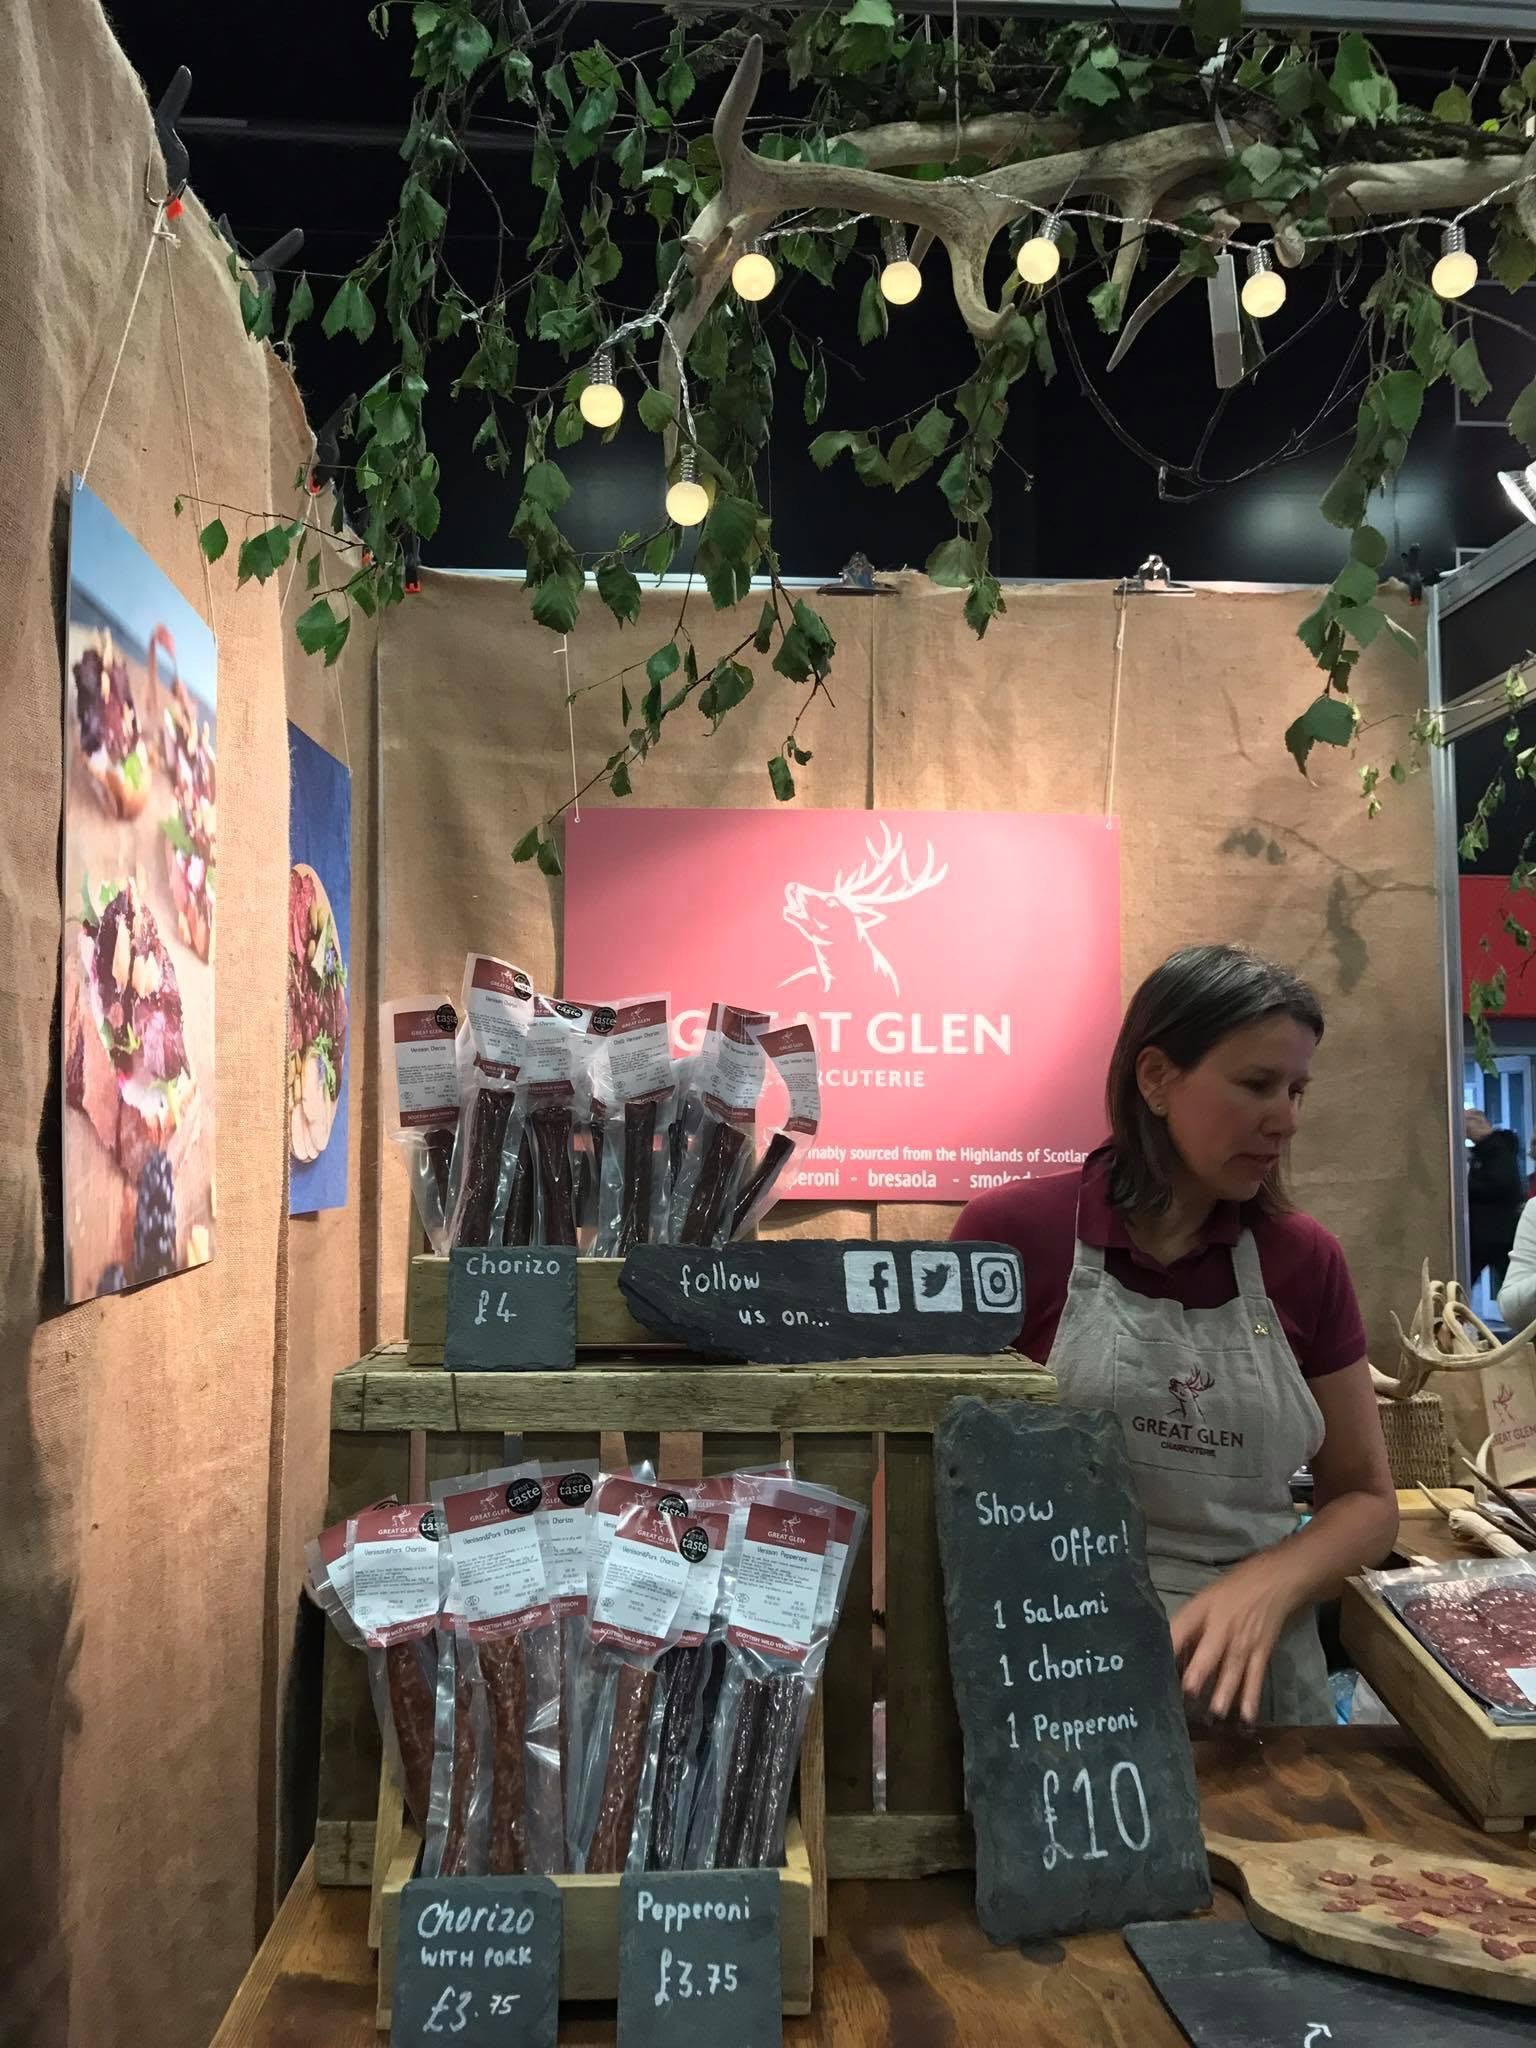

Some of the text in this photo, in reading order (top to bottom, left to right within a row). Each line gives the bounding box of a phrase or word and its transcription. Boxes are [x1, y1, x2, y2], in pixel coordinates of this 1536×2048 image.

[436, 1014, 458, 1025] taste
[557, 1004, 581, 1017] taste
[593, 1016, 617, 1026] taste
[866, 1011, 1012, 1055] GLEN
[850, 1146, 900, 1161] sourced
[902, 1146, 932, 1161] from
[936, 1146, 957, 1162] the
[960, 1147, 1023, 1165] Highlands
[1026, 1148, 1041, 1163] of
[1043, 1148, 1090, 1163] Scotlan
[867, 1168, 937, 1188] bresaola
[680, 1261, 761, 1298] follow
[473, 1290, 518, 1326] £4
[739, 1308, 831, 1328] us on...
[1132, 1416, 1244, 1448] GREAT GLEN
[508, 1486, 541, 1508] taste
[560, 1483, 592, 1496] taste
[469, 1508, 510, 1522] GREAT GLEN
[975, 1491, 1055, 1526] Show
[377, 1528, 399, 1536] GREAT
[503, 1525, 526, 1536] Chorizo
[637, 1529, 674, 1545] GREAT GLEN
[767, 1531, 788, 1541] GREAT
[788, 1535, 806, 1544] GLEN
[682, 1537, 708, 1553] taste
[1050, 1520, 1130, 1567] Offer!
[994, 1591, 1109, 1630] 1 Salami
[478, 1623, 502, 1632] SCOTTISH
[502, 1618, 517, 1628] WILD
[735, 1631, 761, 1643] SCOTTISH
[761, 1639, 775, 1647] WILD
[999, 1655, 1014, 1687] 1
[1006, 1707, 1139, 1752] 1 Pepperoni
[1042, 1761, 1151, 1872] £10
[417, 1900, 535, 1939] Chorizo
[637, 1890, 751, 1933] Pepperoni
[420, 1945, 533, 1968] WITH PORK
[654, 1947, 739, 2007] £3.75
[422, 1986, 521, 2032] £3.75
